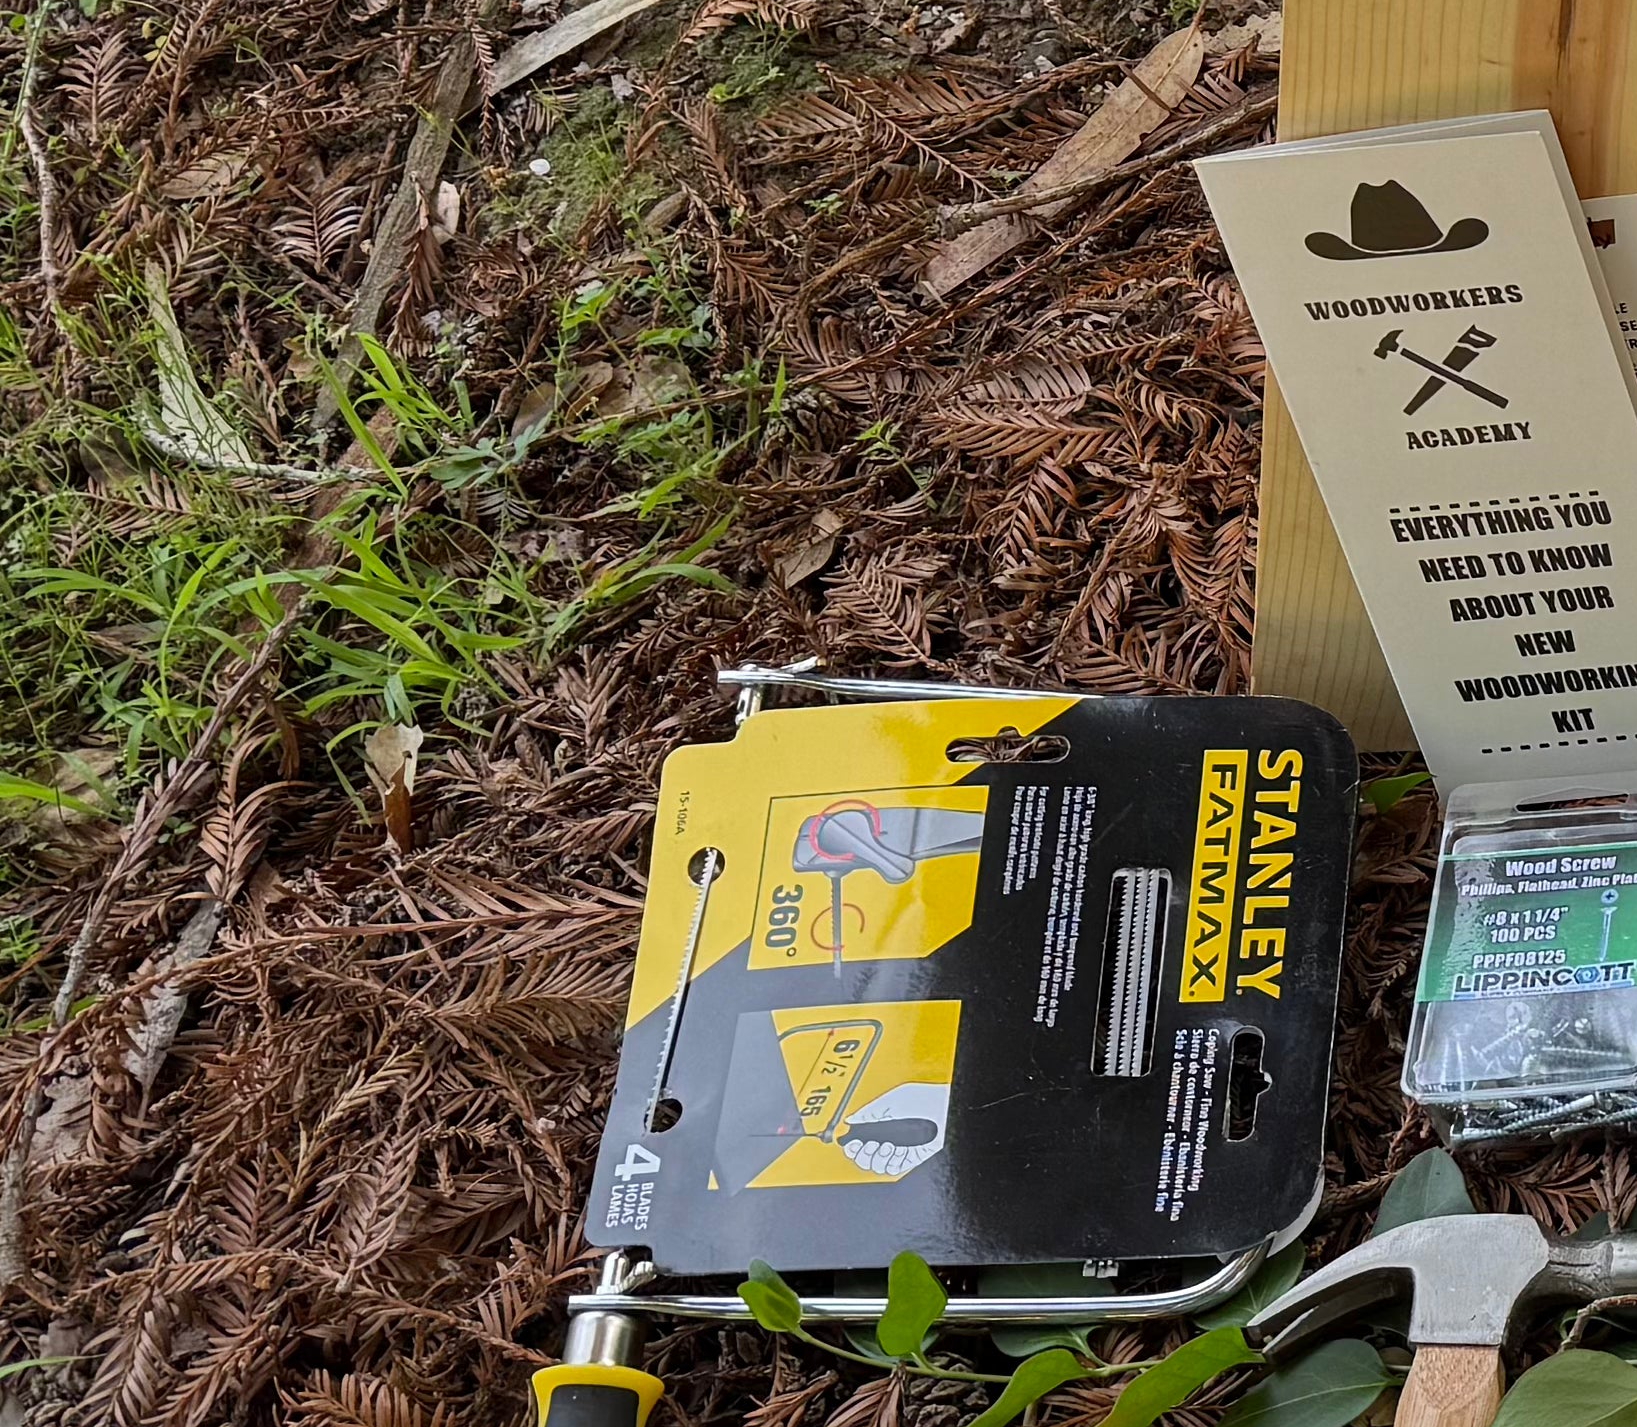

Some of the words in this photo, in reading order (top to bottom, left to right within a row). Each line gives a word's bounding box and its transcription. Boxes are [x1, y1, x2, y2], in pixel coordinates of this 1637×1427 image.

[1304, 284, 1524, 321] WOODWORKERS
[1405, 422, 1532, 450] ACADEMY
[1390, 506, 1553, 543] EVERYTHING
[1555, 501, 1612, 529] YOU
[1418, 553, 1488, 583] NEED
[1491, 550, 1524, 576] TO
[1529, 544, 1613, 575] KNOW
[1449, 594, 1537, 622] ABOUT
[1541, 586, 1615, 613] YOUR
[1515, 631, 1576, 658] NEW
[1552, 708, 1595, 733] KIT
[1189, 764, 1238, 988] FATMAX
[1237, 749, 1303, 1000] STANLEY
[1505, 858, 1557, 877] Wood
[1560, 856, 1616, 872] Screw
[765, 884, 804, 957] 360°
[1490, 927, 1520, 943] 100
[1523, 926, 1556, 942] PCS
[1454, 962, 1635, 994] LIPPINCOTT
[1472, 950, 1566, 969] PPPF08125
[1203, 1029, 1220, 1065] Coping
[1203, 1067, 1216, 1089] Saw
[614, 1144, 660, 1181] 4
[1187, 1121, 1209, 1191] Woodworking
[606, 1184, 626, 1229] LAMES
[621, 1183, 640, 1223] HOJAS
[634, 1181, 654, 1230] BLADES
